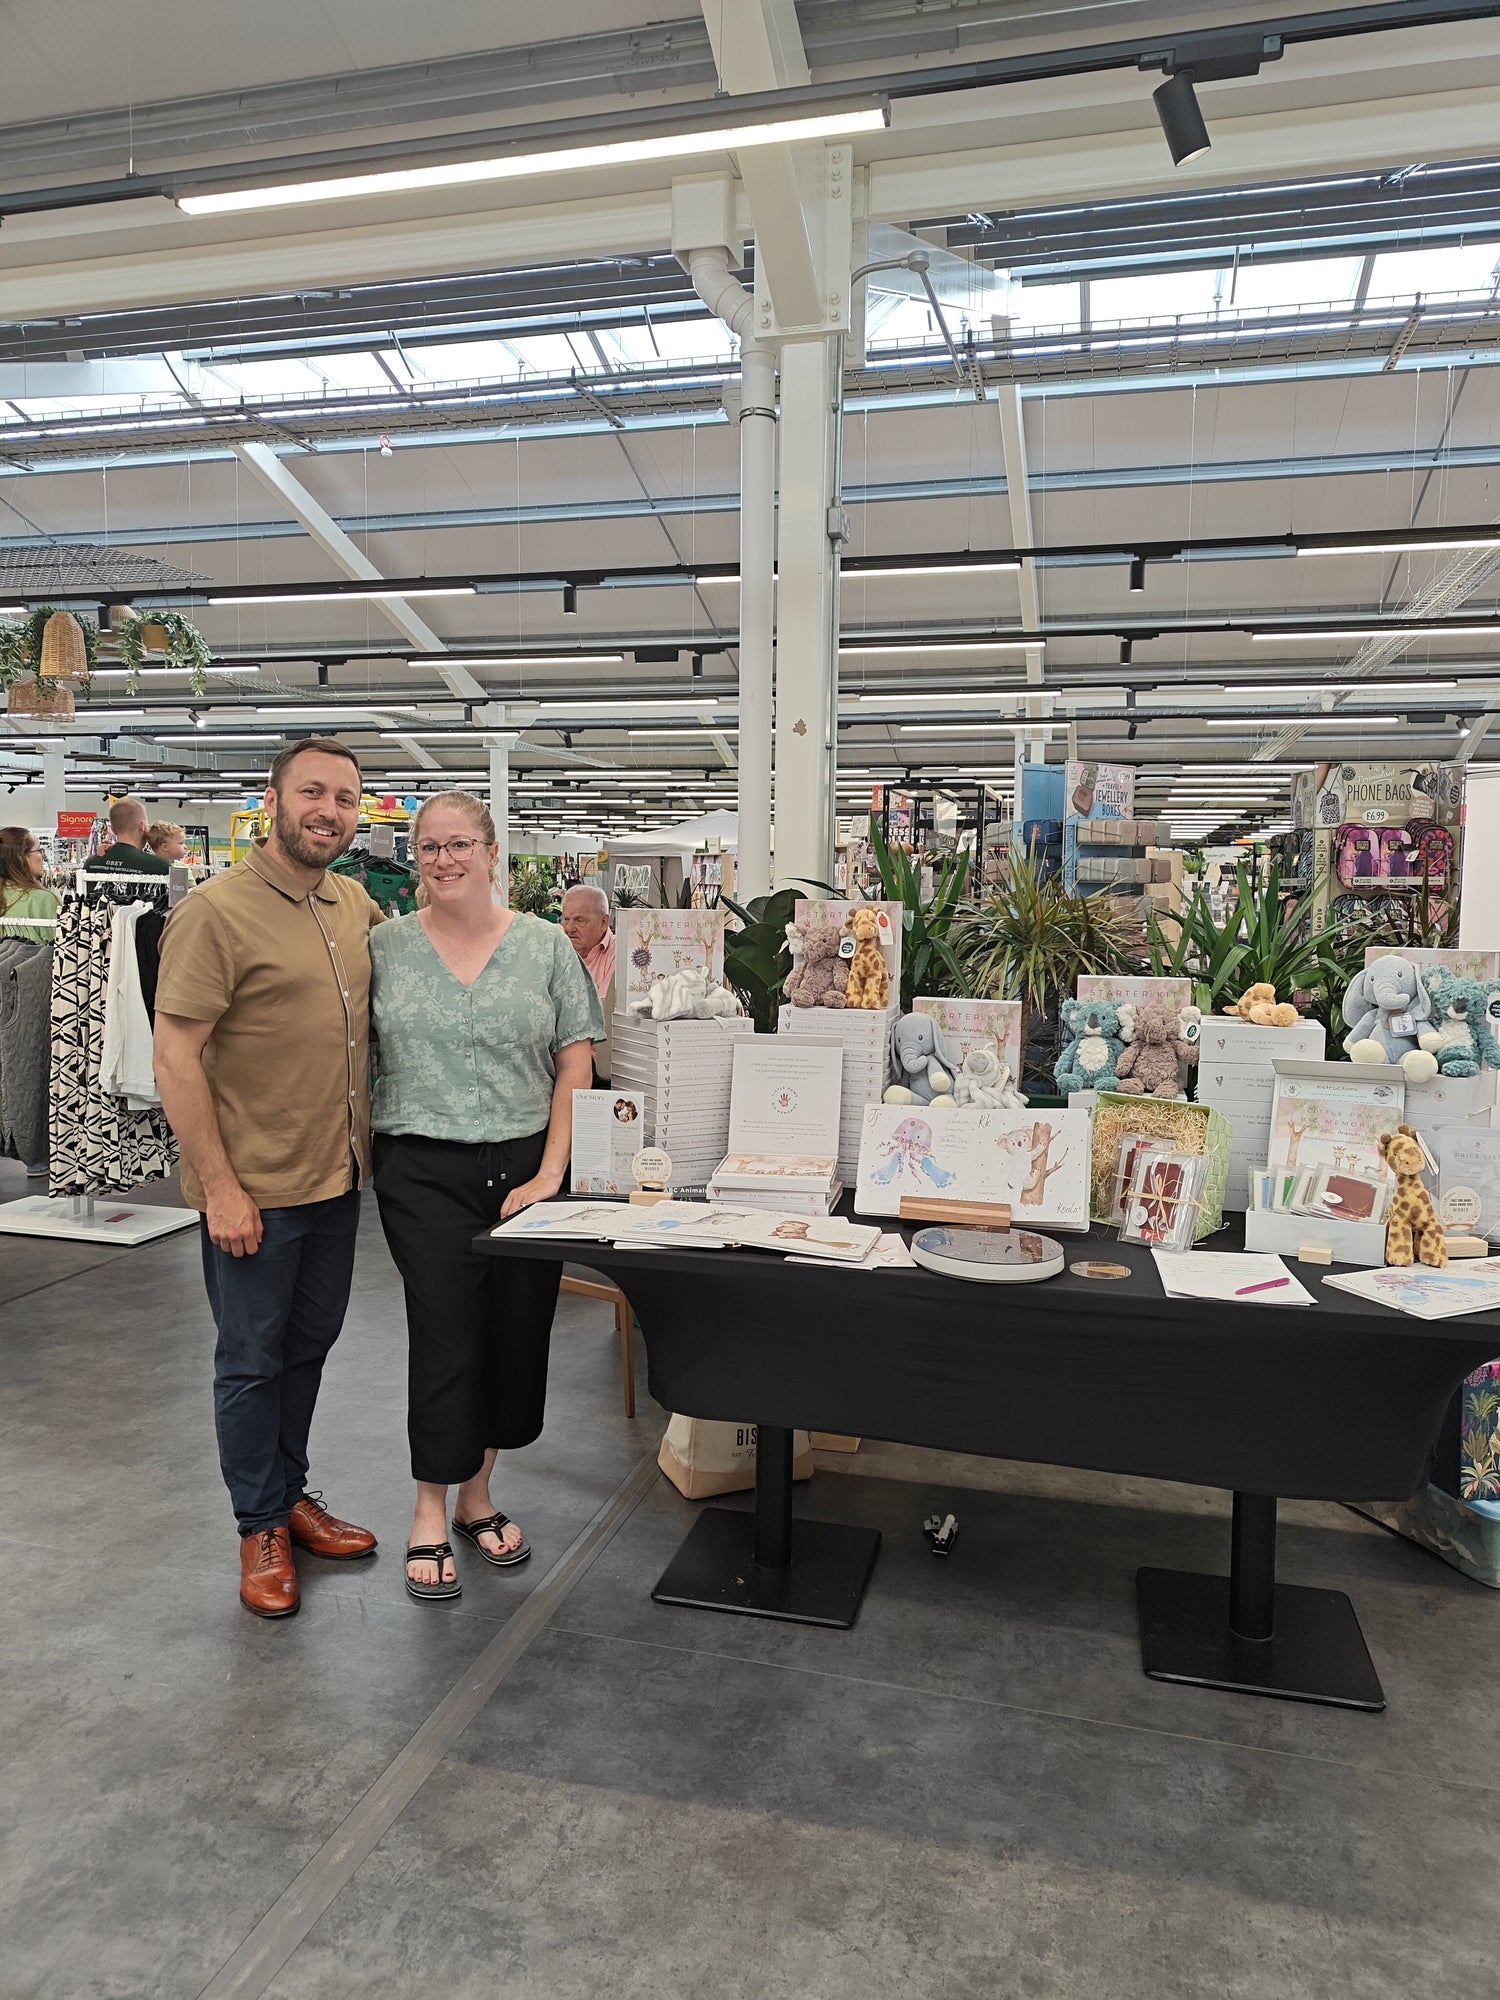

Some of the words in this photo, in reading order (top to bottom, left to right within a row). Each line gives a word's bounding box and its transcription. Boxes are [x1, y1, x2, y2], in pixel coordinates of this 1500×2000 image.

[1095, 789, 1129, 803] JEWELLERY
[1347, 784, 1382, 801] PHONE
[1385, 783, 1412, 801] BAGS
[1102, 803, 1121, 817] BOXES
[1366, 811, 1385, 821] £6.99
[105, 859, 124, 867] OBEY
[639, 921, 690, 929] STARTER
[697, 921, 714, 929] KIT
[1455, 964, 1479, 972] KIT
[1090, 989, 1149, 998] STARTER
[931, 1012, 980, 1021] TARTER
[1307, 1108, 1343, 1117] LITTLE
[1349, 1111, 1381, 1120] PAWS
[1325, 1119, 1384, 1130] MEMORIES
[1056, 1202, 1079, 1214] Koala
